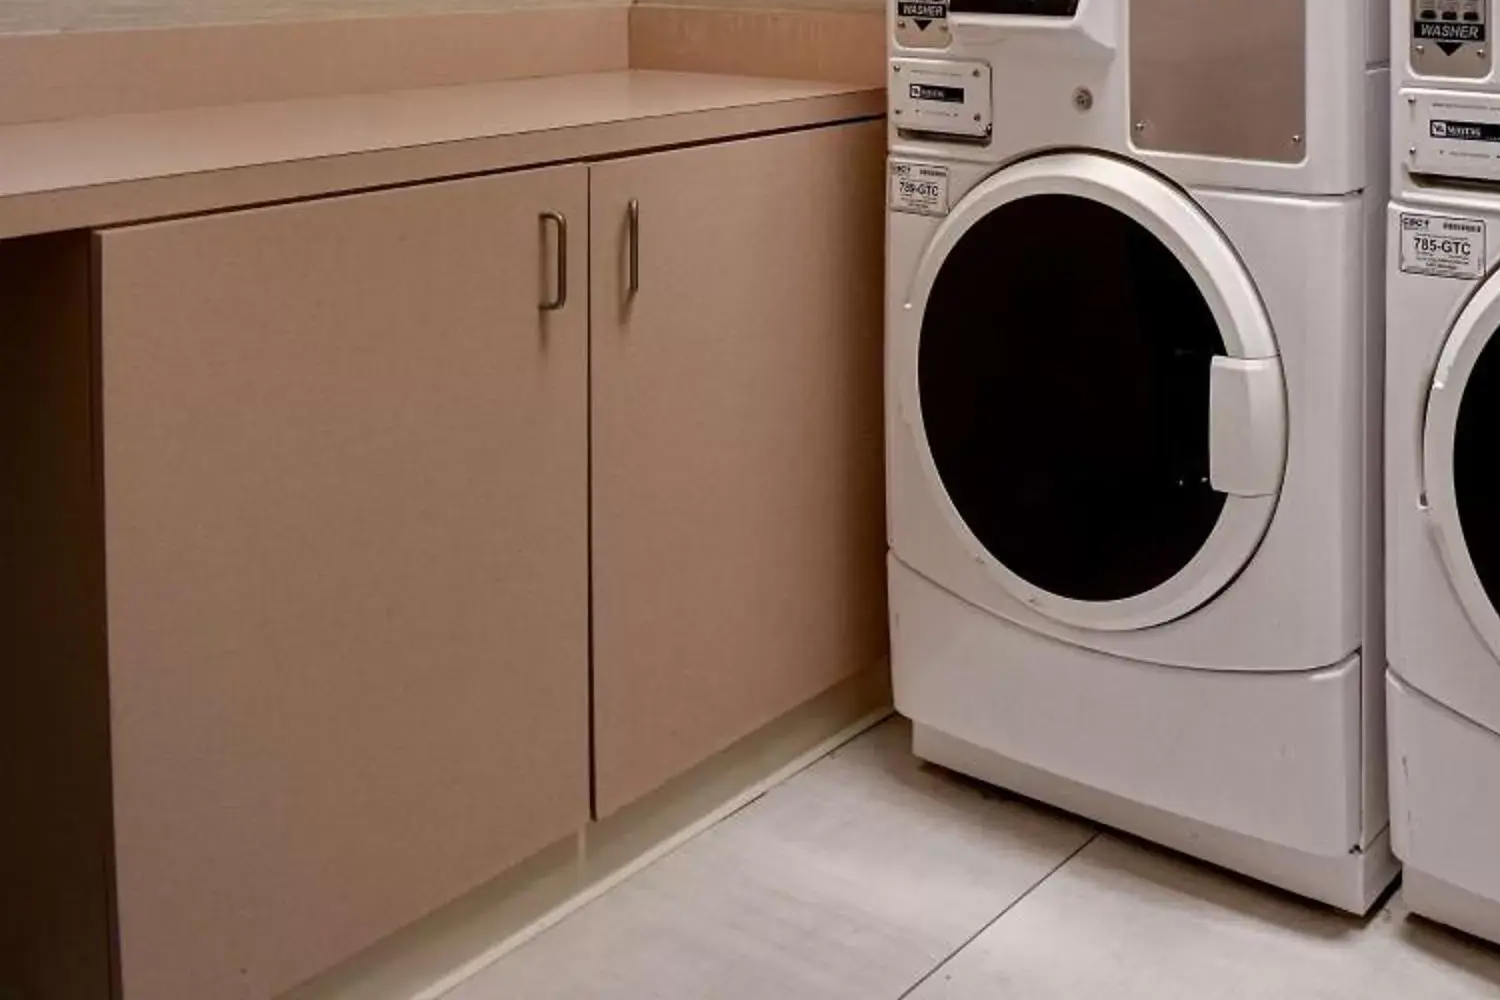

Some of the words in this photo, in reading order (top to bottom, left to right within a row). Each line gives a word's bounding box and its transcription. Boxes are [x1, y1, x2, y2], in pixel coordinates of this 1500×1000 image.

[903, 3, 943, 16] WASHER
[1420, 23, 1479, 39] WASHER
[1413, 236, 1471, 256] 785-GTC
